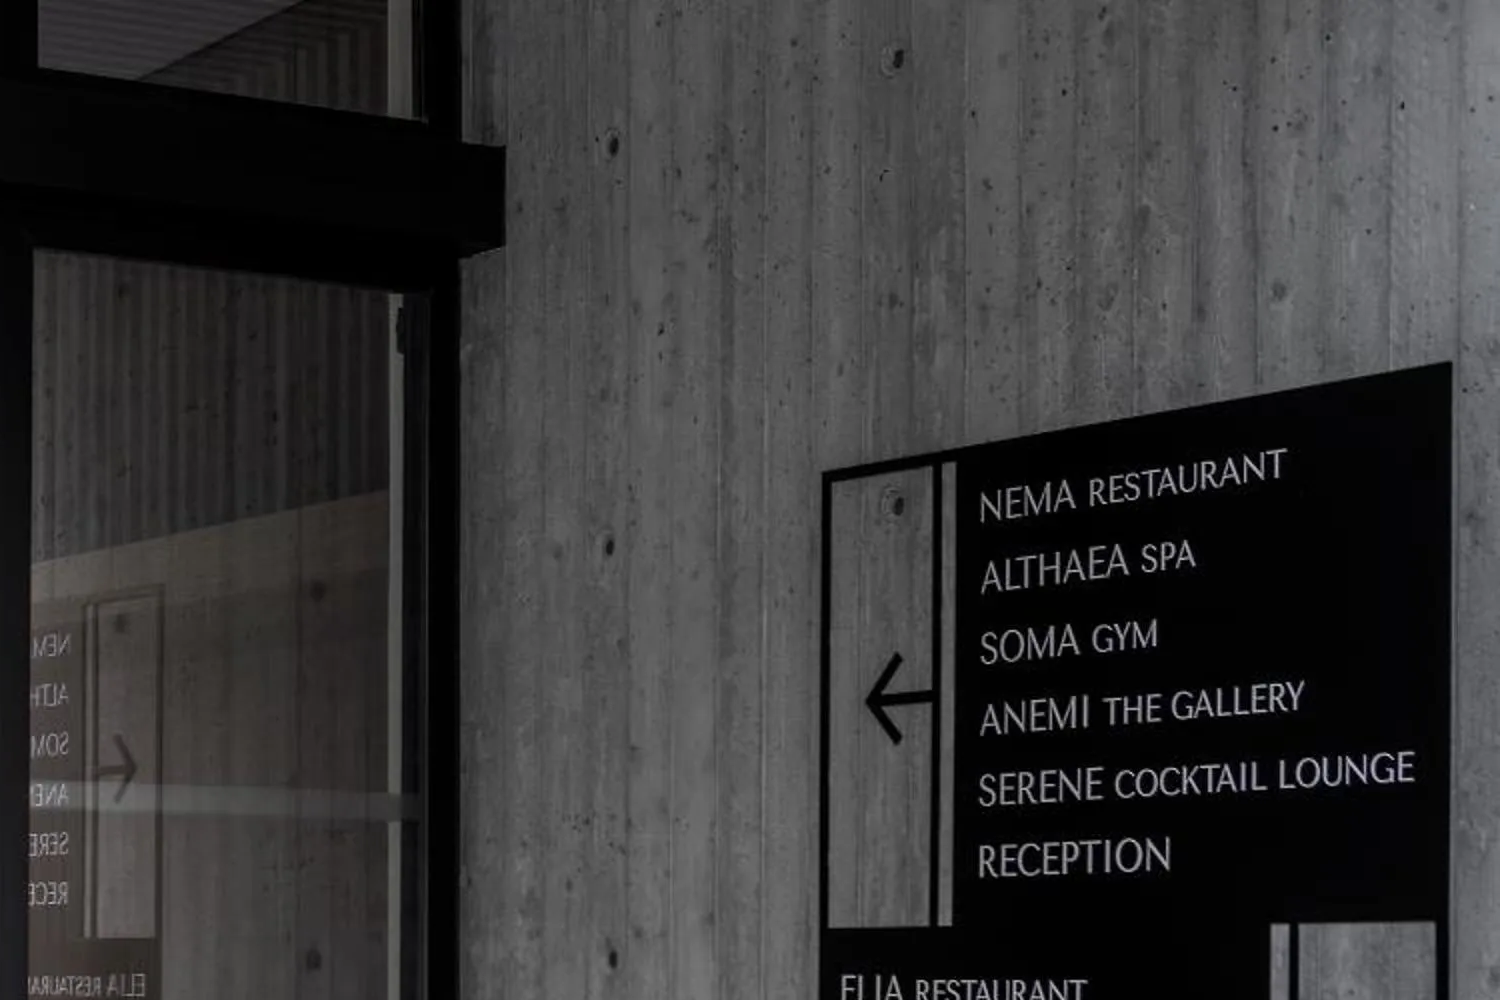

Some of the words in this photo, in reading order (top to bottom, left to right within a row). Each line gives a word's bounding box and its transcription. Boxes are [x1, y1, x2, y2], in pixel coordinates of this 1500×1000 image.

[980, 479, 1077, 523] NEMA
[1089, 447, 1288, 507] RESTAURANT
[981, 543, 1130, 594] ALTHAEA
[1141, 539, 1197, 573] SPA
[980, 623, 1081, 665] SOMA
[1091, 618, 1158, 653] GYM
[979, 694, 1089, 737] ANEMI
[1102, 693, 1163, 726] THE
[1171, 679, 1305, 721] GALLERY
[978, 766, 1104, 807] SERENE
[1114, 761, 1268, 799] COCKTAIL
[1279, 750, 1416, 789] LOUNGE
[979, 836, 1171, 878] RECEPTION
